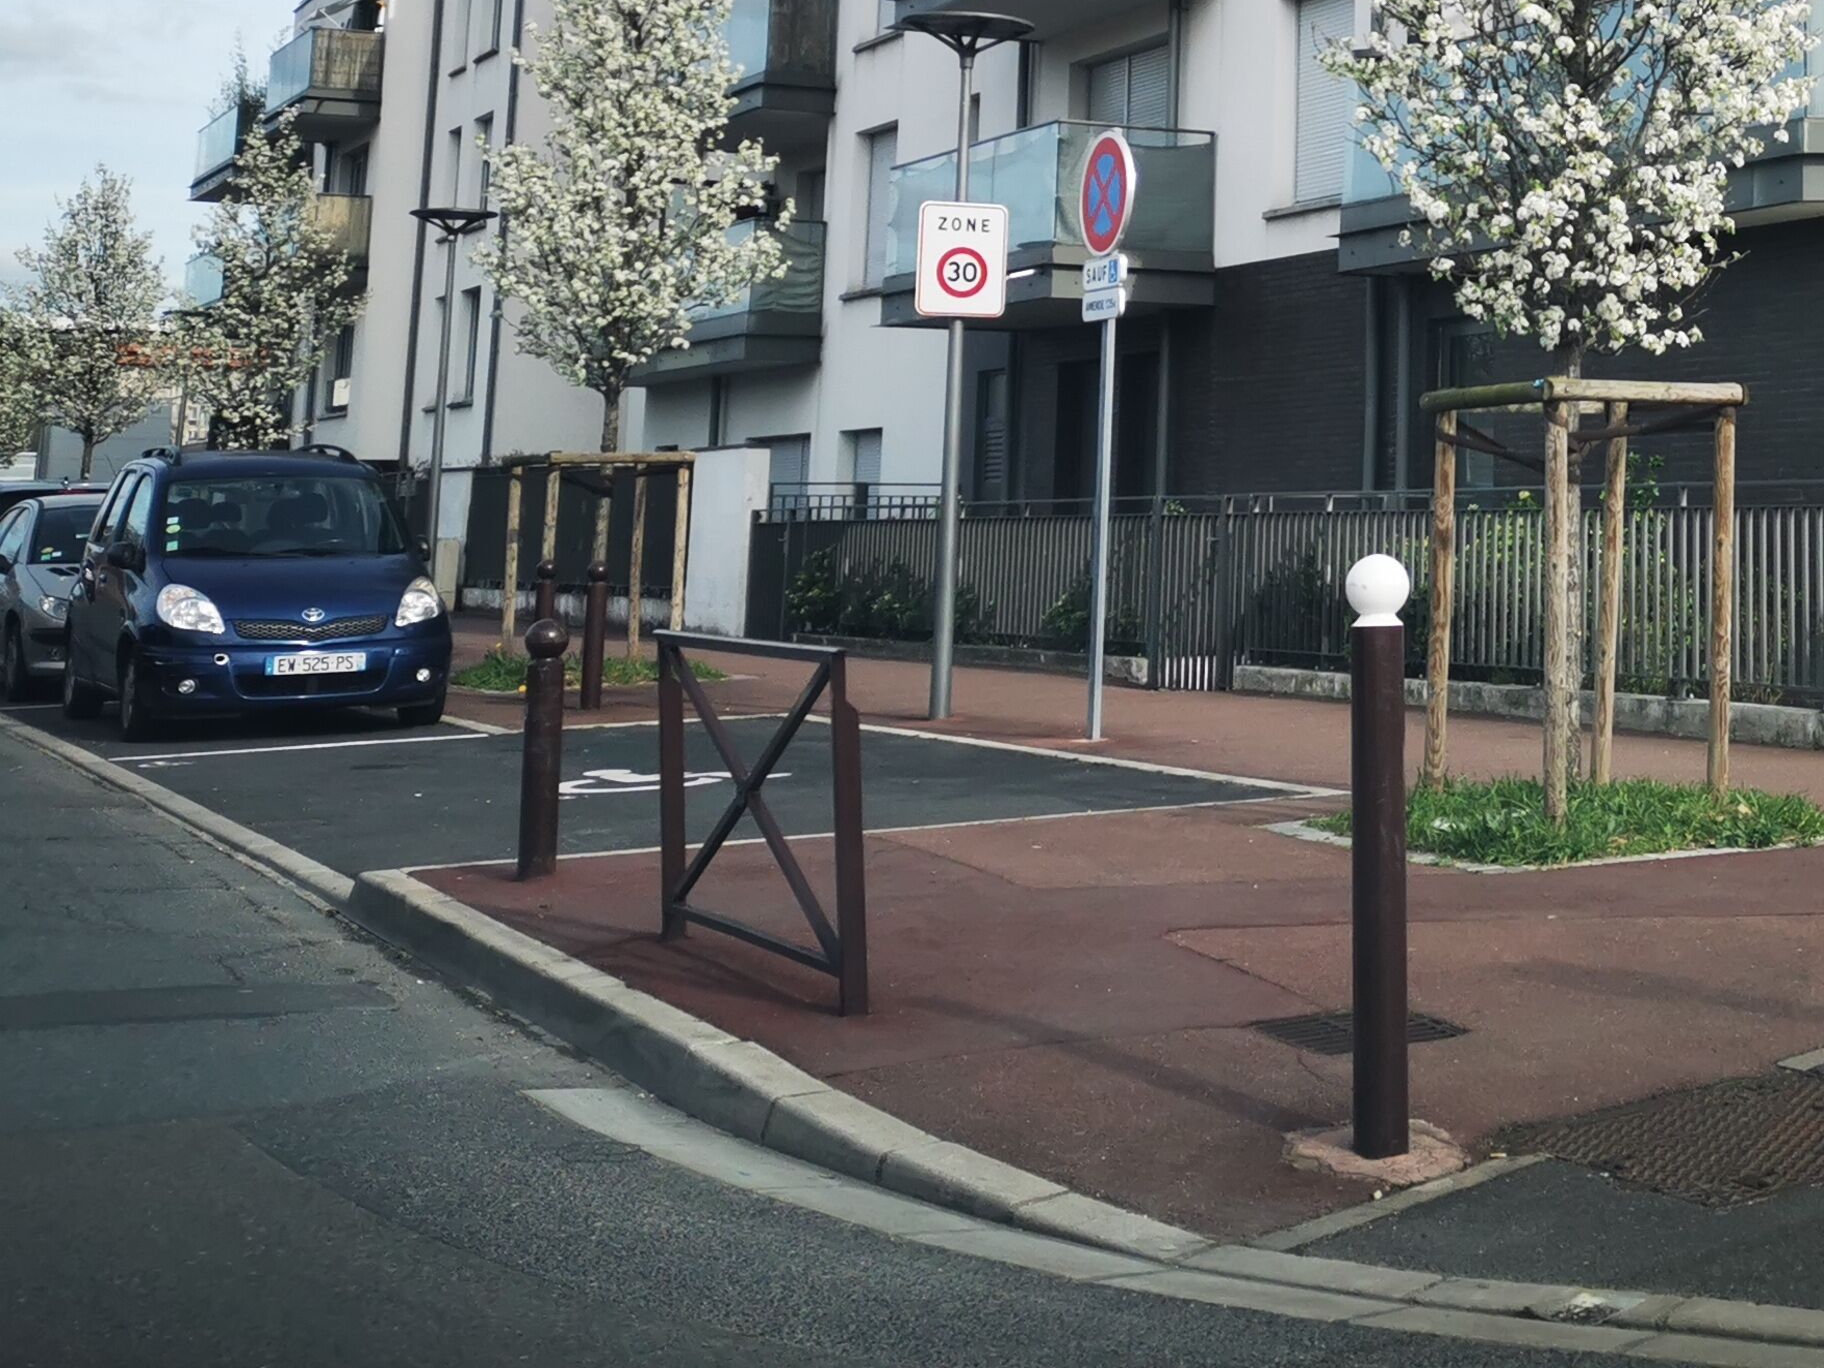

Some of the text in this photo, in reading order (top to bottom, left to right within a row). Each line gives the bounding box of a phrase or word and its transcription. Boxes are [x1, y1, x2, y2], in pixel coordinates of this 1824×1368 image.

[937, 216, 990, 233] ZONE
[947, 261, 977, 282] 30
[1086, 265, 1107, 284] SAUF
